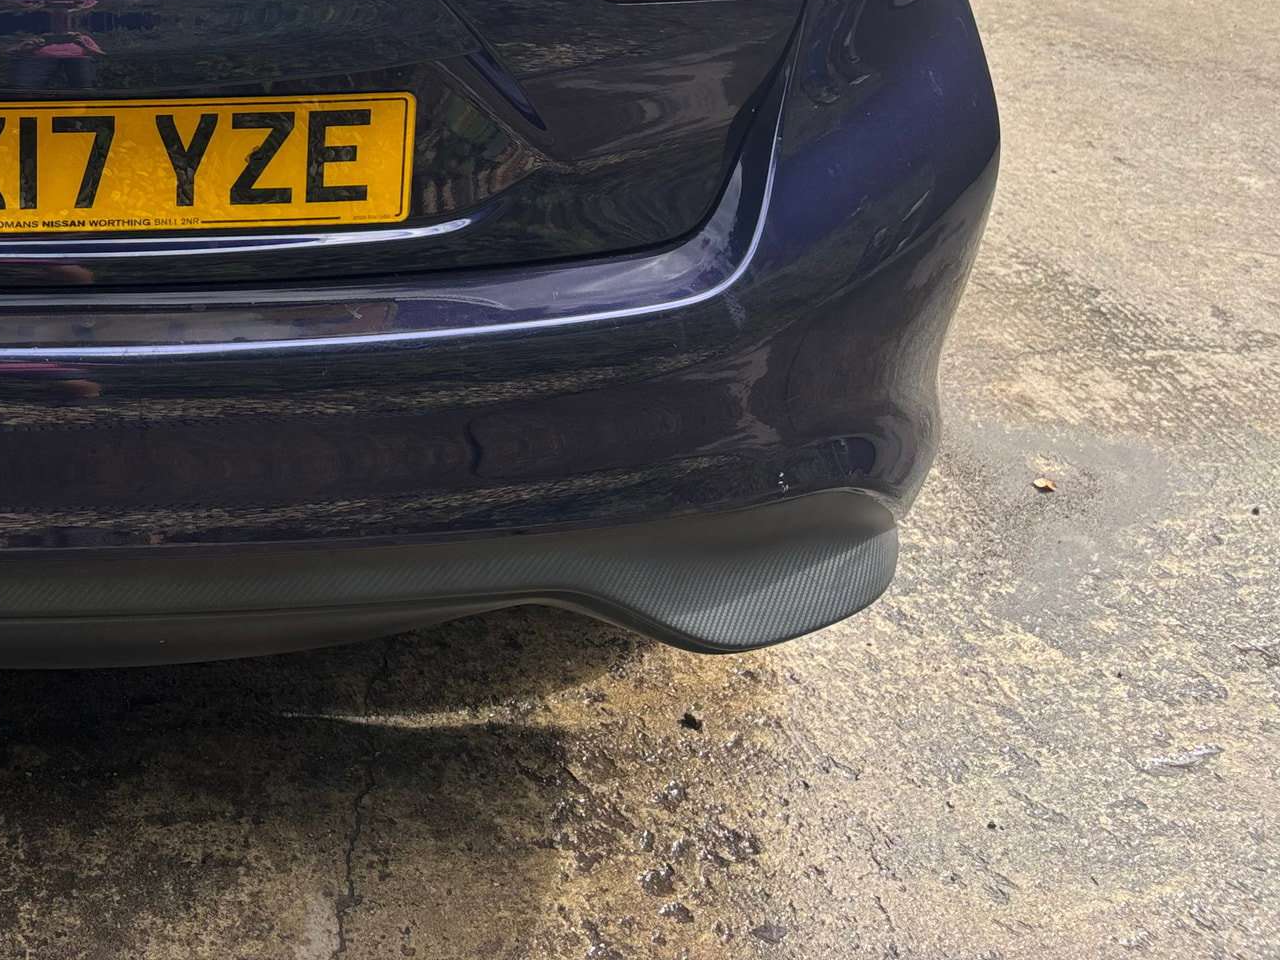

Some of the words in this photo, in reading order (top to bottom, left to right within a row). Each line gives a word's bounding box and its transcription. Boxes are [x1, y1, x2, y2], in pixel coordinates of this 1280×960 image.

[155, 108, 371, 207] YZE
[42, 220, 85, 229] NISSAN
[89, 218, 151, 228] WORTHING
